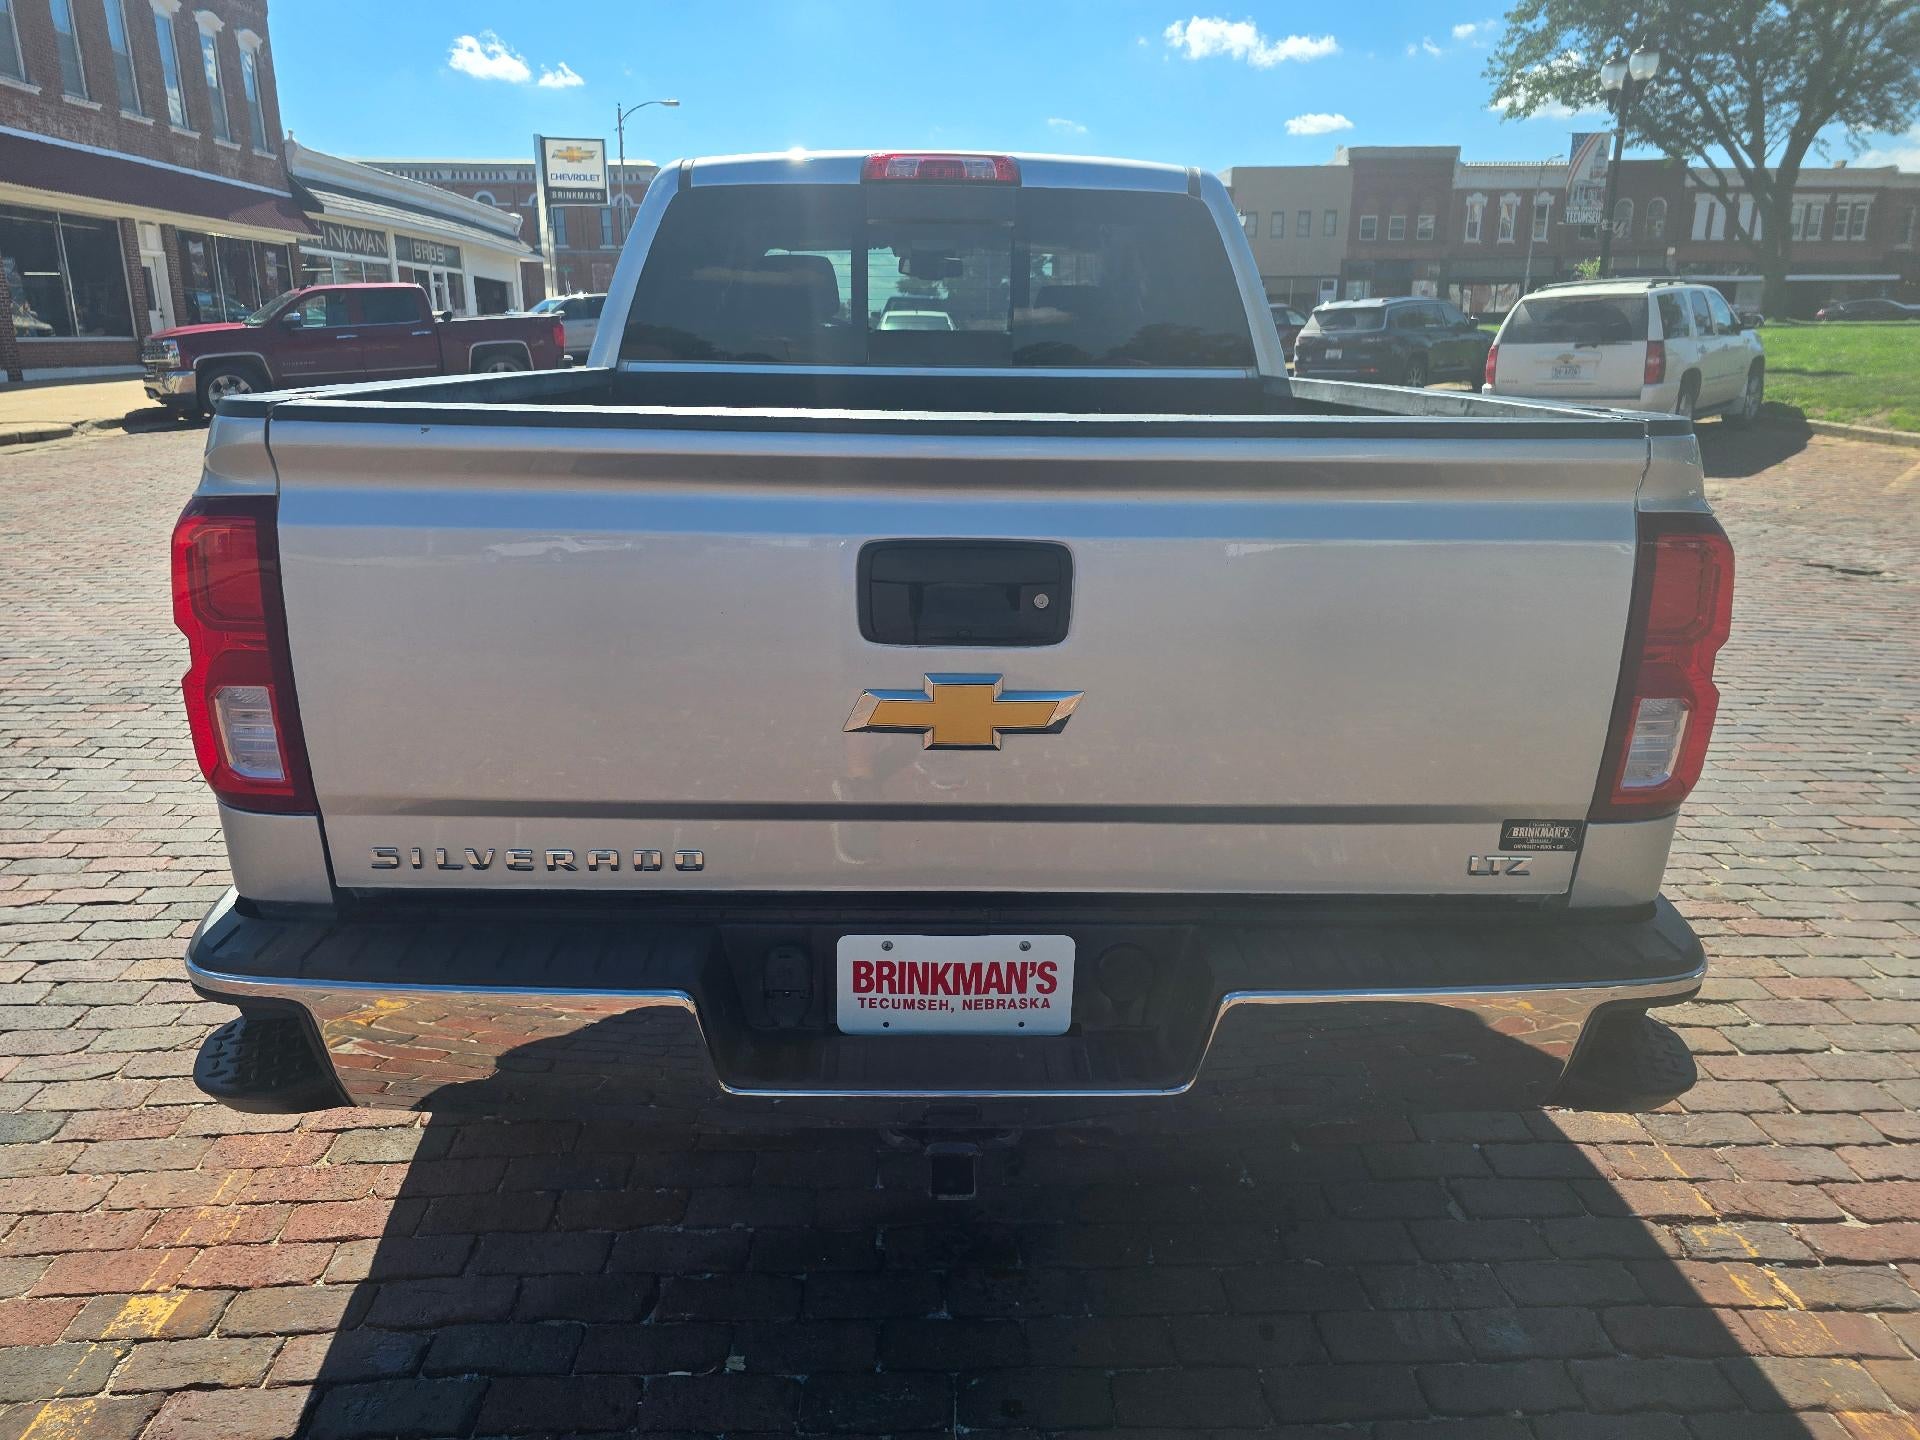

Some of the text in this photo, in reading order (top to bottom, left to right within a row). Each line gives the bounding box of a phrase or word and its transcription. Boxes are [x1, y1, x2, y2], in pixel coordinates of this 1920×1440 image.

[551, 172, 601, 182] CHEVROLET
[552, 190, 602, 201] BRINKMAN'S
[413, 240, 446, 263] BROS
[1512, 827, 1570, 838] BRINKMAN'S
[371, 847, 705, 872] SILVERADO
[1468, 856, 1533, 875] LTZ
[852, 960, 1058, 996] BRINKMAN'S
[857, 997, 1051, 1014] TECUMSEH, NEBRASKA
